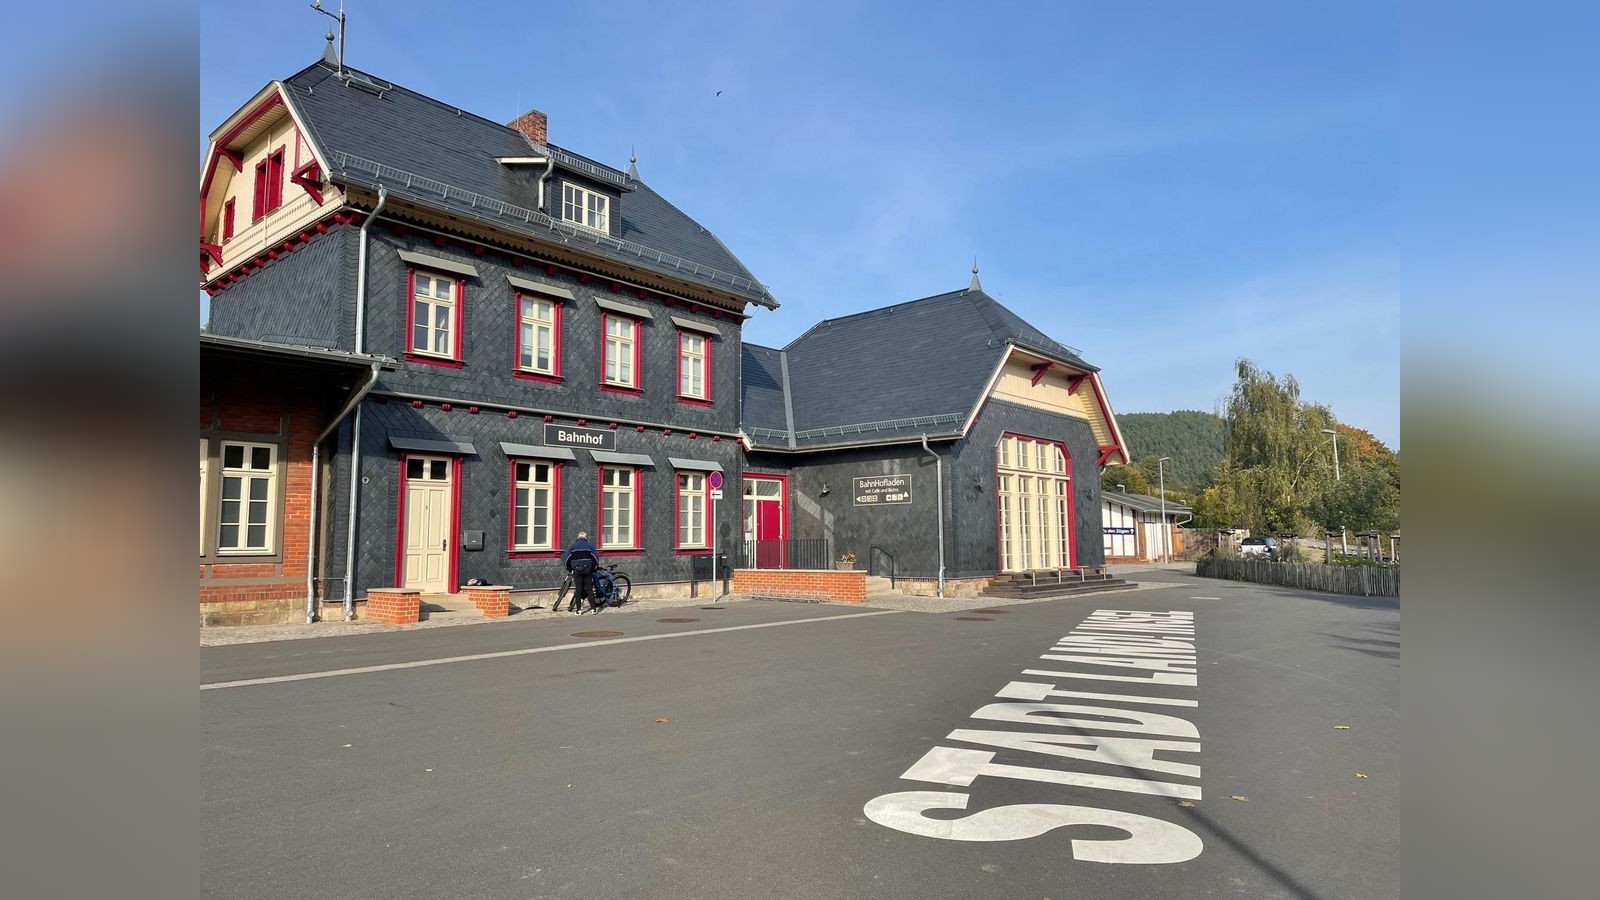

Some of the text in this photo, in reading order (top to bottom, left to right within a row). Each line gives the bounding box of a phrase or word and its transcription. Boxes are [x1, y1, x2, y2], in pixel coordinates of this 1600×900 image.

[558, 430, 603, 445] Bahnhof
[860, 479, 905, 488] BahnHofladen
[863, 680, 1204, 865] STADT
[1075, 609, 1197, 635] INSEL
